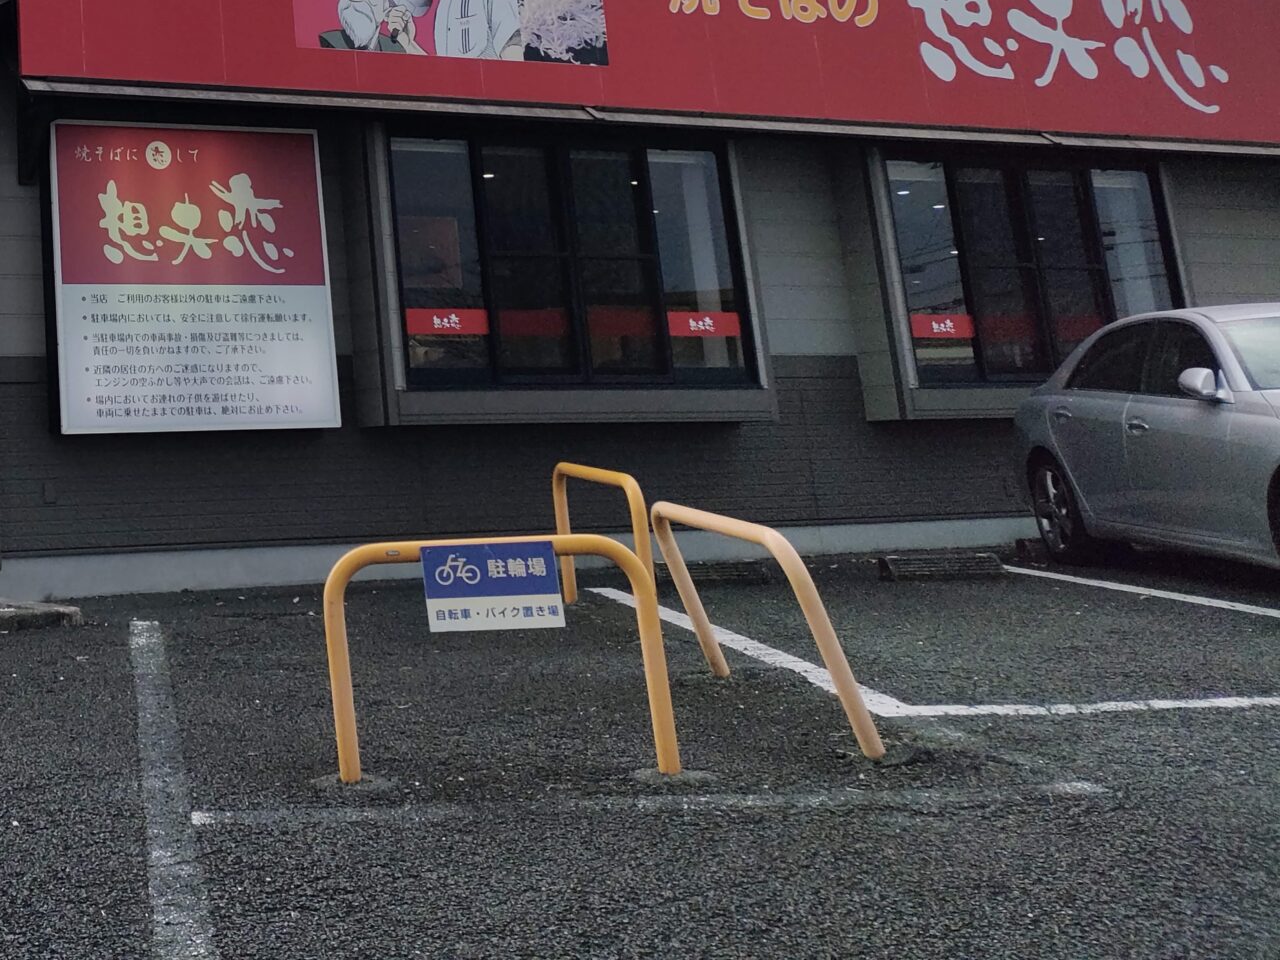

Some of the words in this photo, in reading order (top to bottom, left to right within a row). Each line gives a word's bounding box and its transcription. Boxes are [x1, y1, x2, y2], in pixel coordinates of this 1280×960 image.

[97, 173, 294, 274] 想夫恋
[487, 556, 547, 579] 駐輪場
[436, 604, 560, 622] 自転車・バイク置き場
